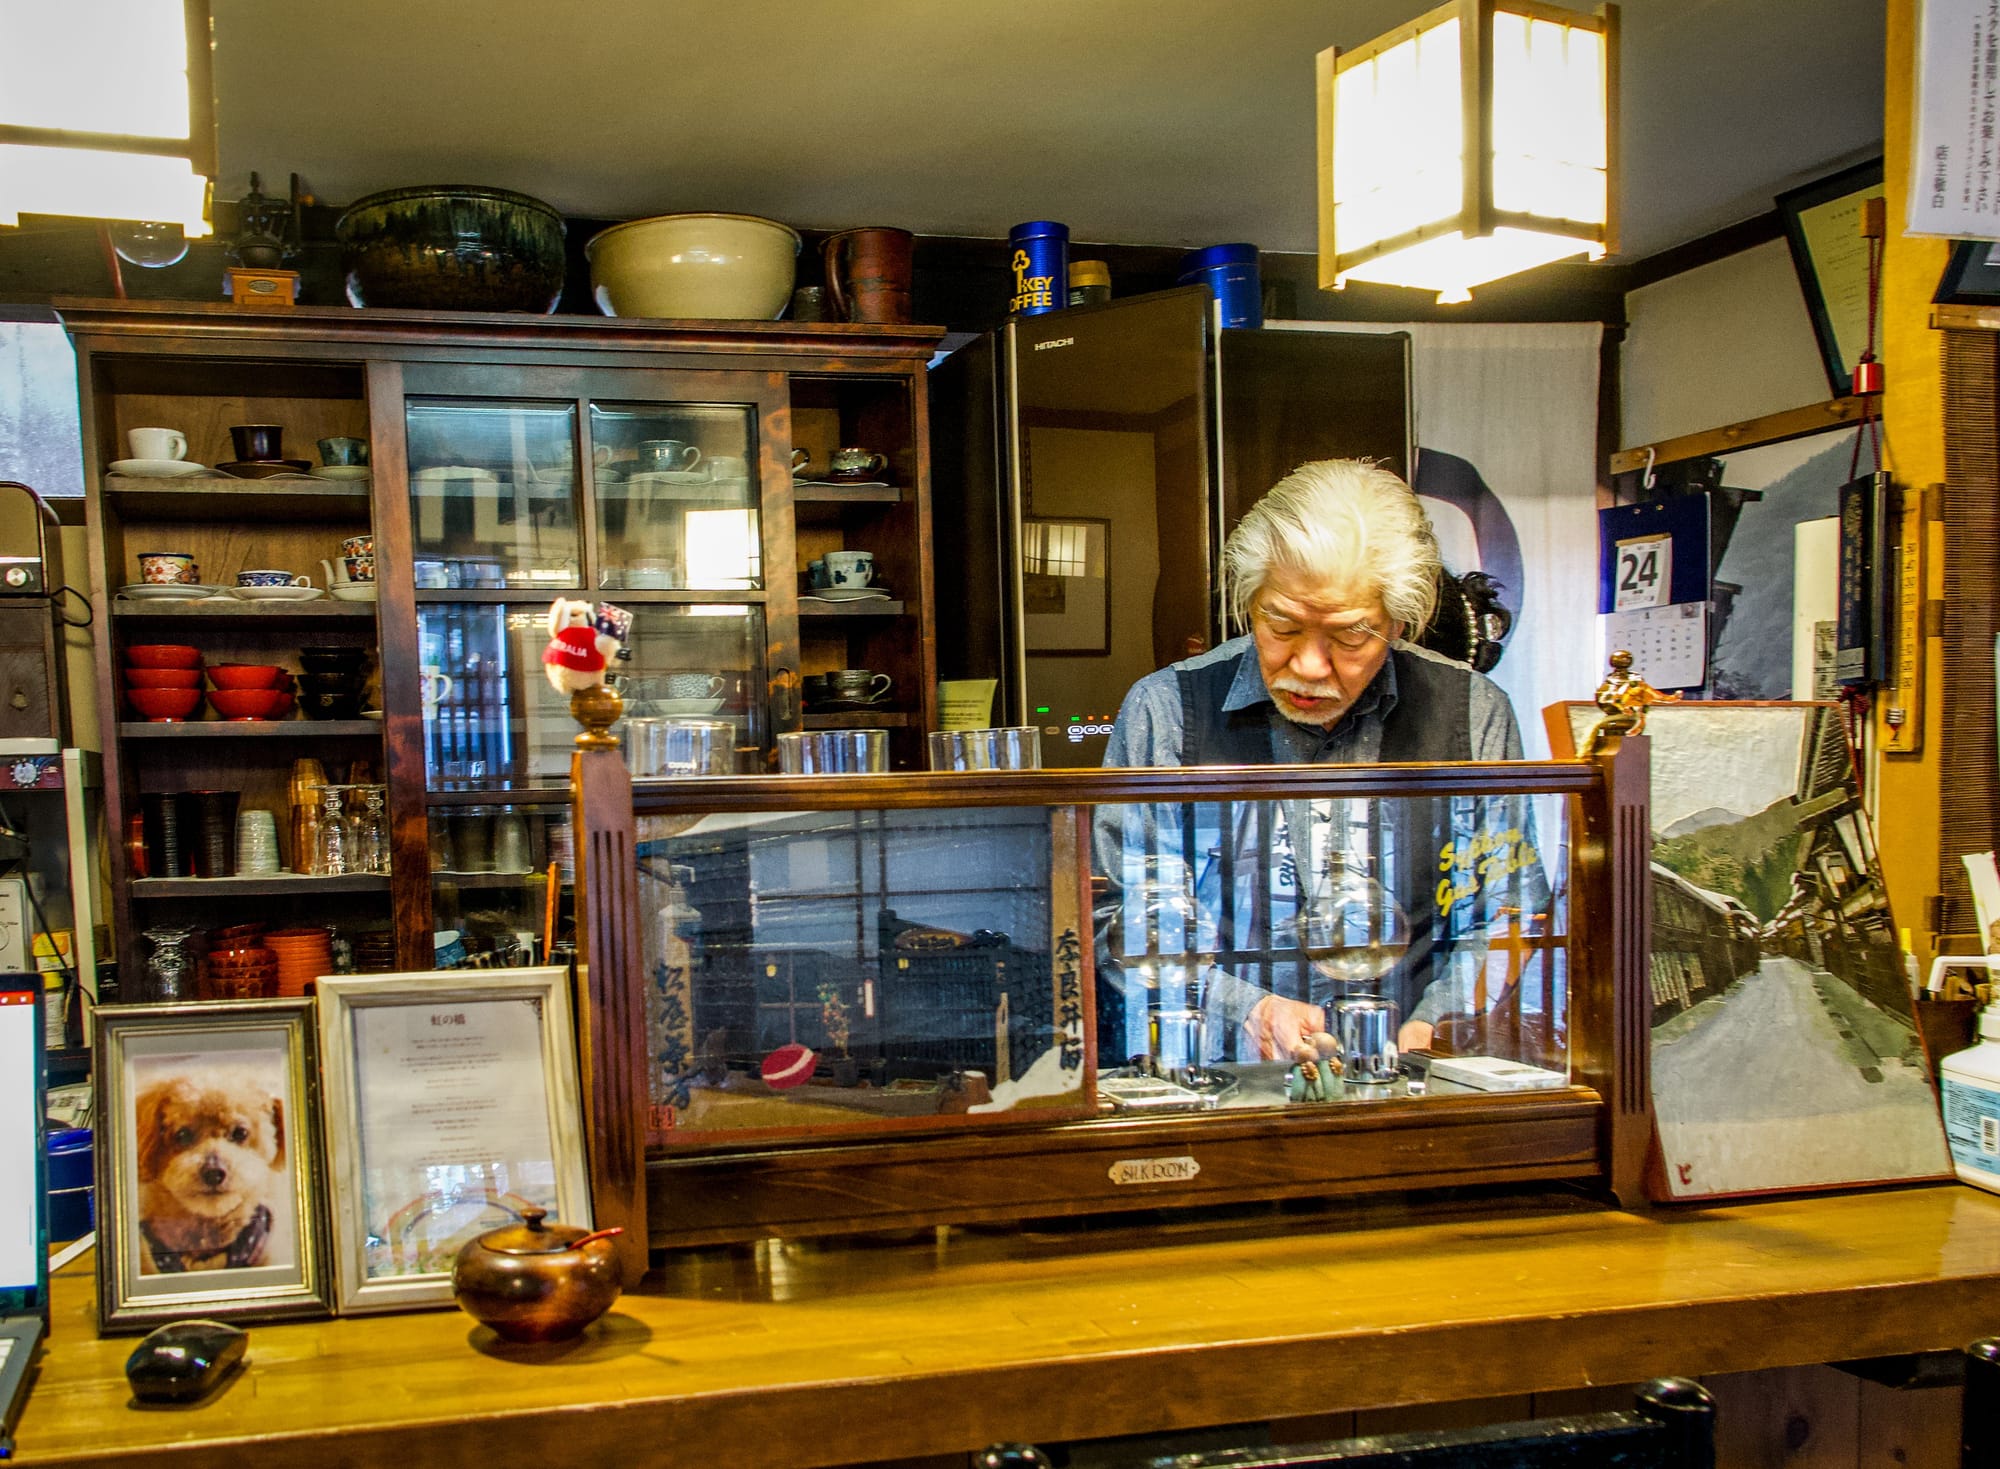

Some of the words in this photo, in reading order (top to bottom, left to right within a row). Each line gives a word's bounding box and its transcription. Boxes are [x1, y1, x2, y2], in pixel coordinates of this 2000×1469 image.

[1021, 276, 1054, 292] KEY
[1009, 291, 1052, 313] OFFEE
[1034, 337, 1074, 351] HITACHI
[1621, 550, 1659, 591] 24
[430, 1013, 467, 1026] 虹の橋
